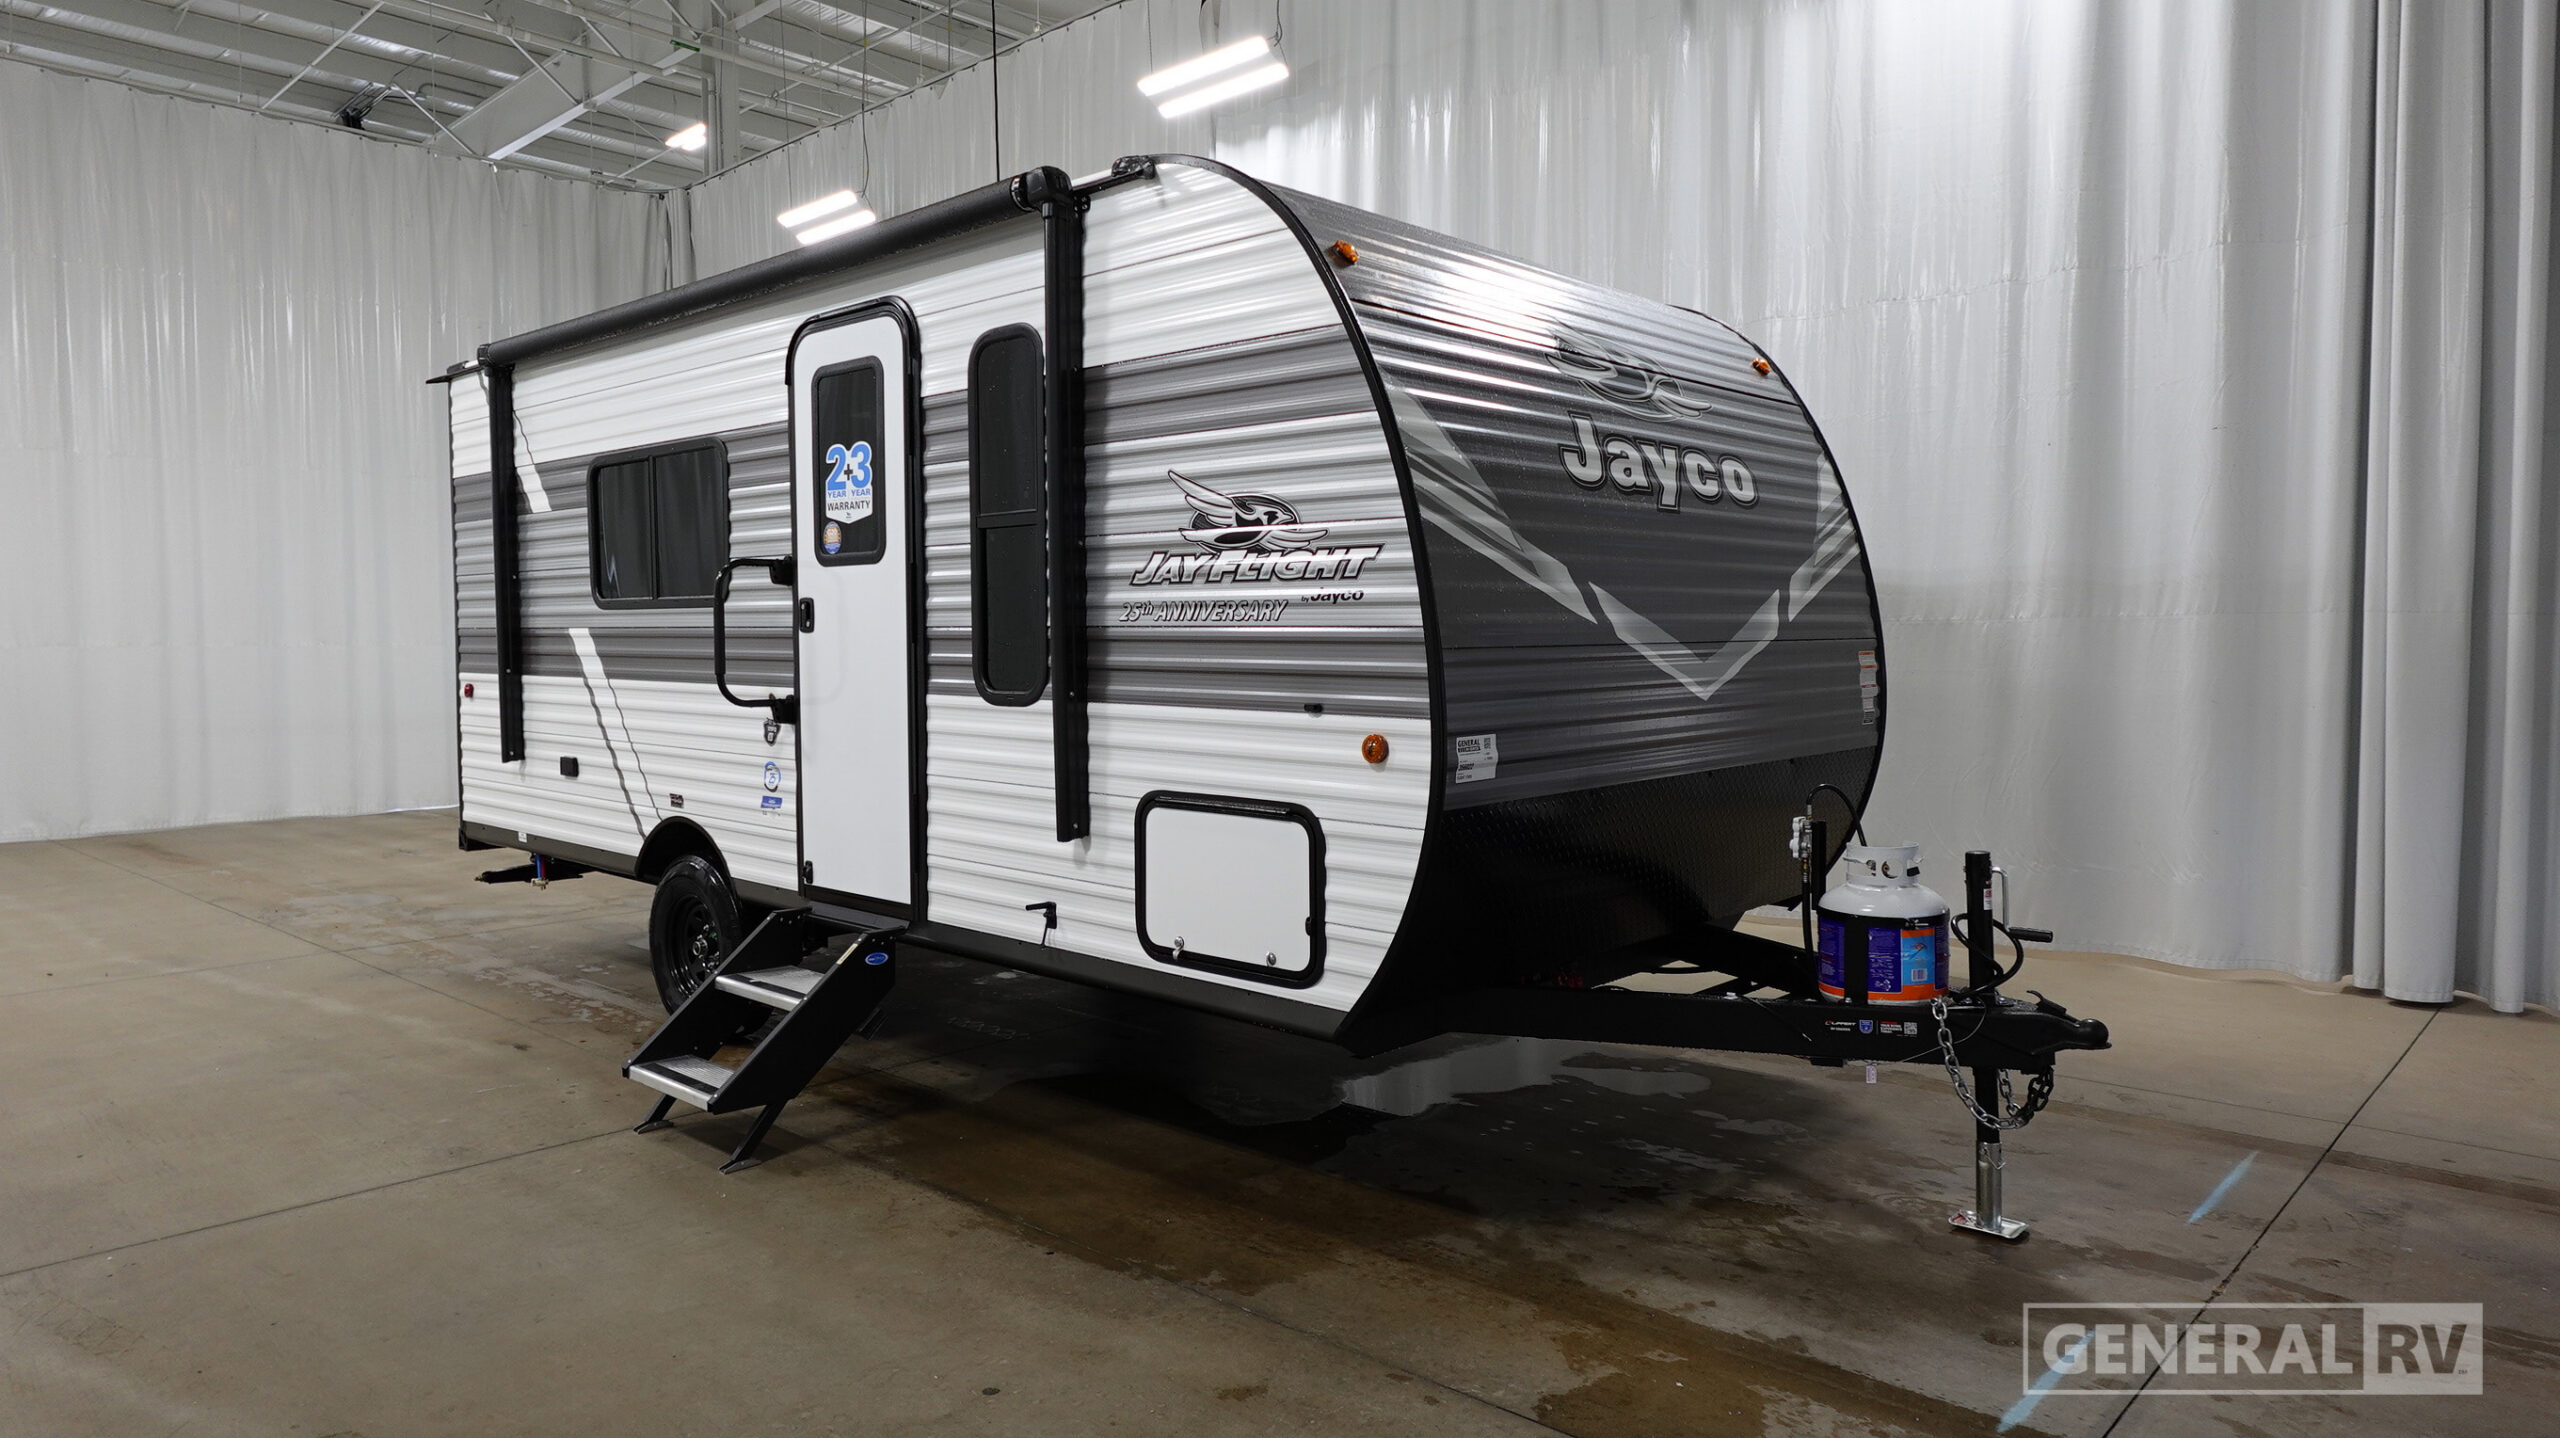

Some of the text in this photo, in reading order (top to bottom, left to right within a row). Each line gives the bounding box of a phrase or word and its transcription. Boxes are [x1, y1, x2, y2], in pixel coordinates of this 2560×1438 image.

[1558, 411, 1760, 514] Jayco
[827, 488, 871, 499] YEAR YEAR
[827, 500, 871, 512] WARRANTY
[1129, 543, 1386, 586] JAY FLIGHT
[1118, 599, 1289, 622] 25th ANNIVERSARY
